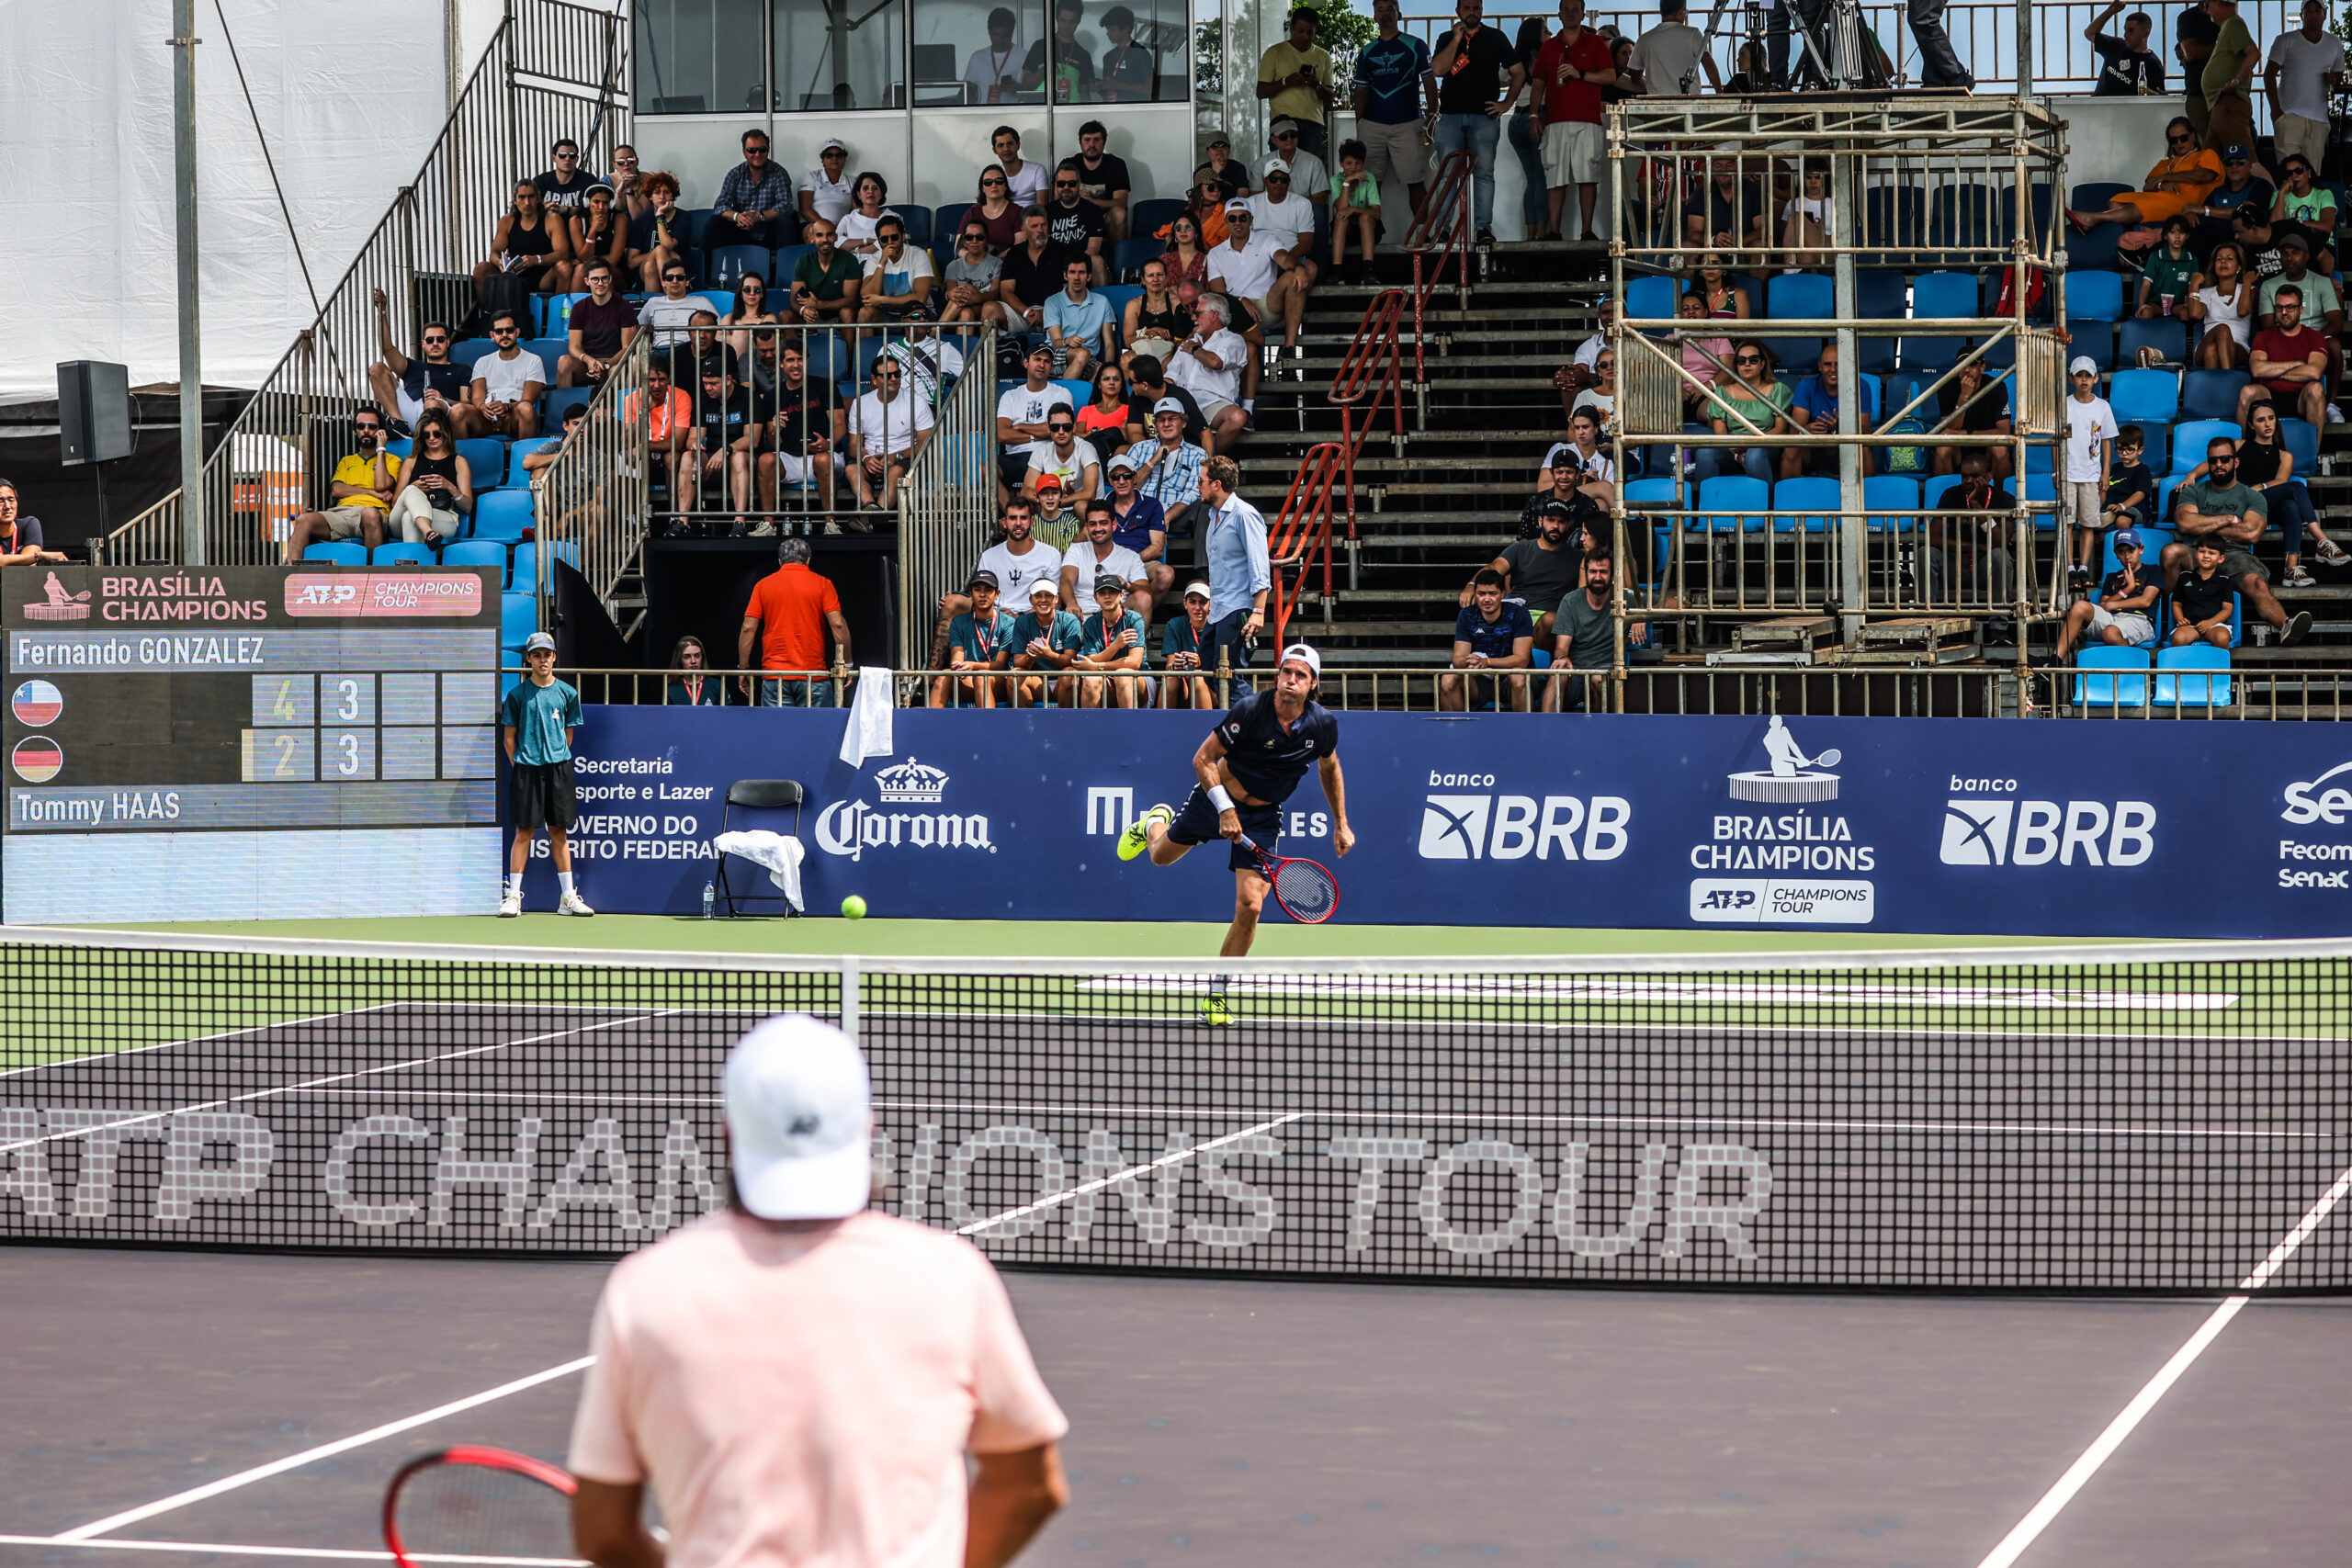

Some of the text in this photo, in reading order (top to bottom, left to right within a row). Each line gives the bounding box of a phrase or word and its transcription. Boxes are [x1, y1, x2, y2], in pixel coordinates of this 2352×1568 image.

[543, 190, 581, 208] ARMY
[1051, 214, 1079, 232] NIKE
[1050, 225, 1087, 243] TENNIS
[102, 570, 227, 597] BRASÍLIA
[374, 582, 475, 596] CHAMPIONS
[295, 585, 356, 604] ATP
[373, 595, 418, 608] TOUR
[102, 600, 267, 621] CHAMPIONS
[17, 637, 265, 665] Fernando GONZALEZ
[274, 679, 359, 721] 4 3
[274, 734, 359, 776] 2 3
[573, 756, 673, 774] Secretaria
[1429, 770, 1496, 787] banco
[1949, 774, 2018, 792] banco
[575, 783, 714, 804] sporte e Lazer
[17, 791, 181, 827] Tommy HAAS
[663, 816, 698, 835] DO
[814, 798, 993, 863] Corona
[1489, 795, 1632, 861] BRB
[1713, 808, 1852, 841] BRASÍLIA
[2012, 800, 2157, 867] BRB
[1690, 844, 1875, 872] CHAMPIONS
[2278, 868, 2349, 889] Senac
[1698, 890, 1756, 909] ATP
[1772, 888, 1868, 901] CHAMPIONS
[1771, 901, 1814, 914] TOUR
[1328, 1136, 1774, 1261] TOUR
